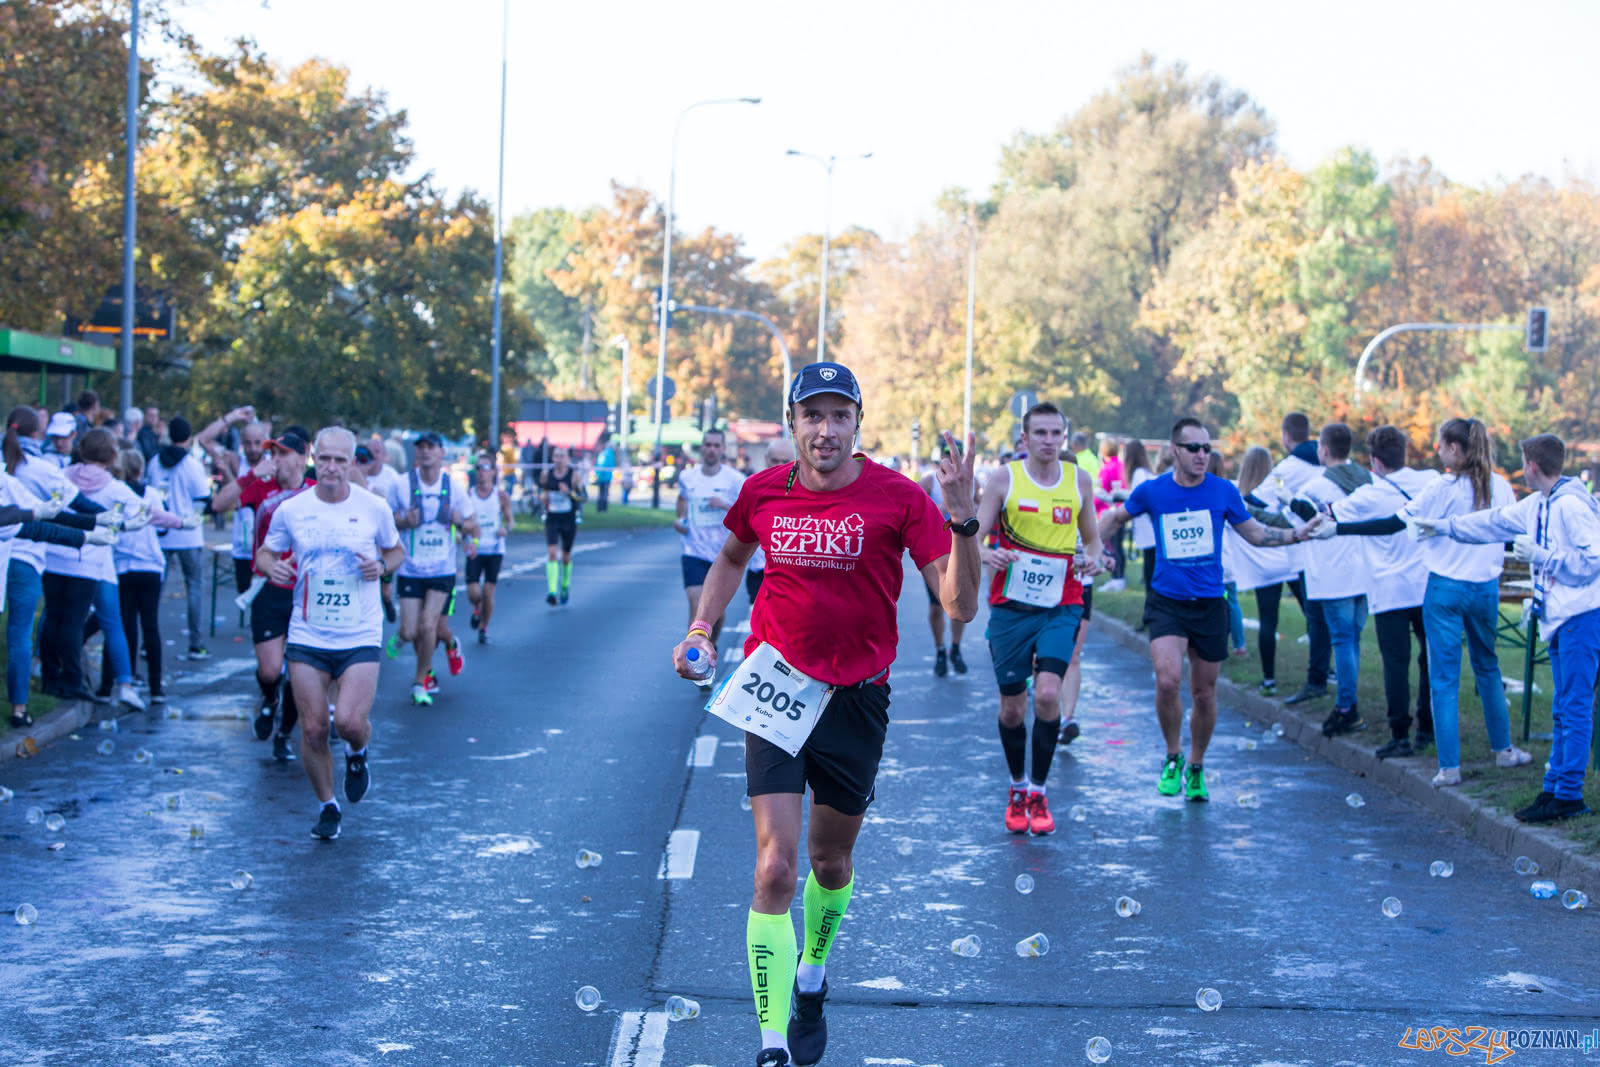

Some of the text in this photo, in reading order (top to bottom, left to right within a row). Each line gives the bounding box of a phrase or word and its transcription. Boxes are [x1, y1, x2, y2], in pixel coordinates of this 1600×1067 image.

[772, 514, 848, 534] DRUŻYNA
[1172, 526, 1205, 541] 5039
[770, 531, 865, 557] SZPIKU
[771, 556, 856, 571] www.darszpiku.pl
[1022, 569, 1054, 587] 1897
[316, 592, 351, 607] 2723
[741, 672, 807, 721] 2005
[754, 705, 774, 719] Kuba
